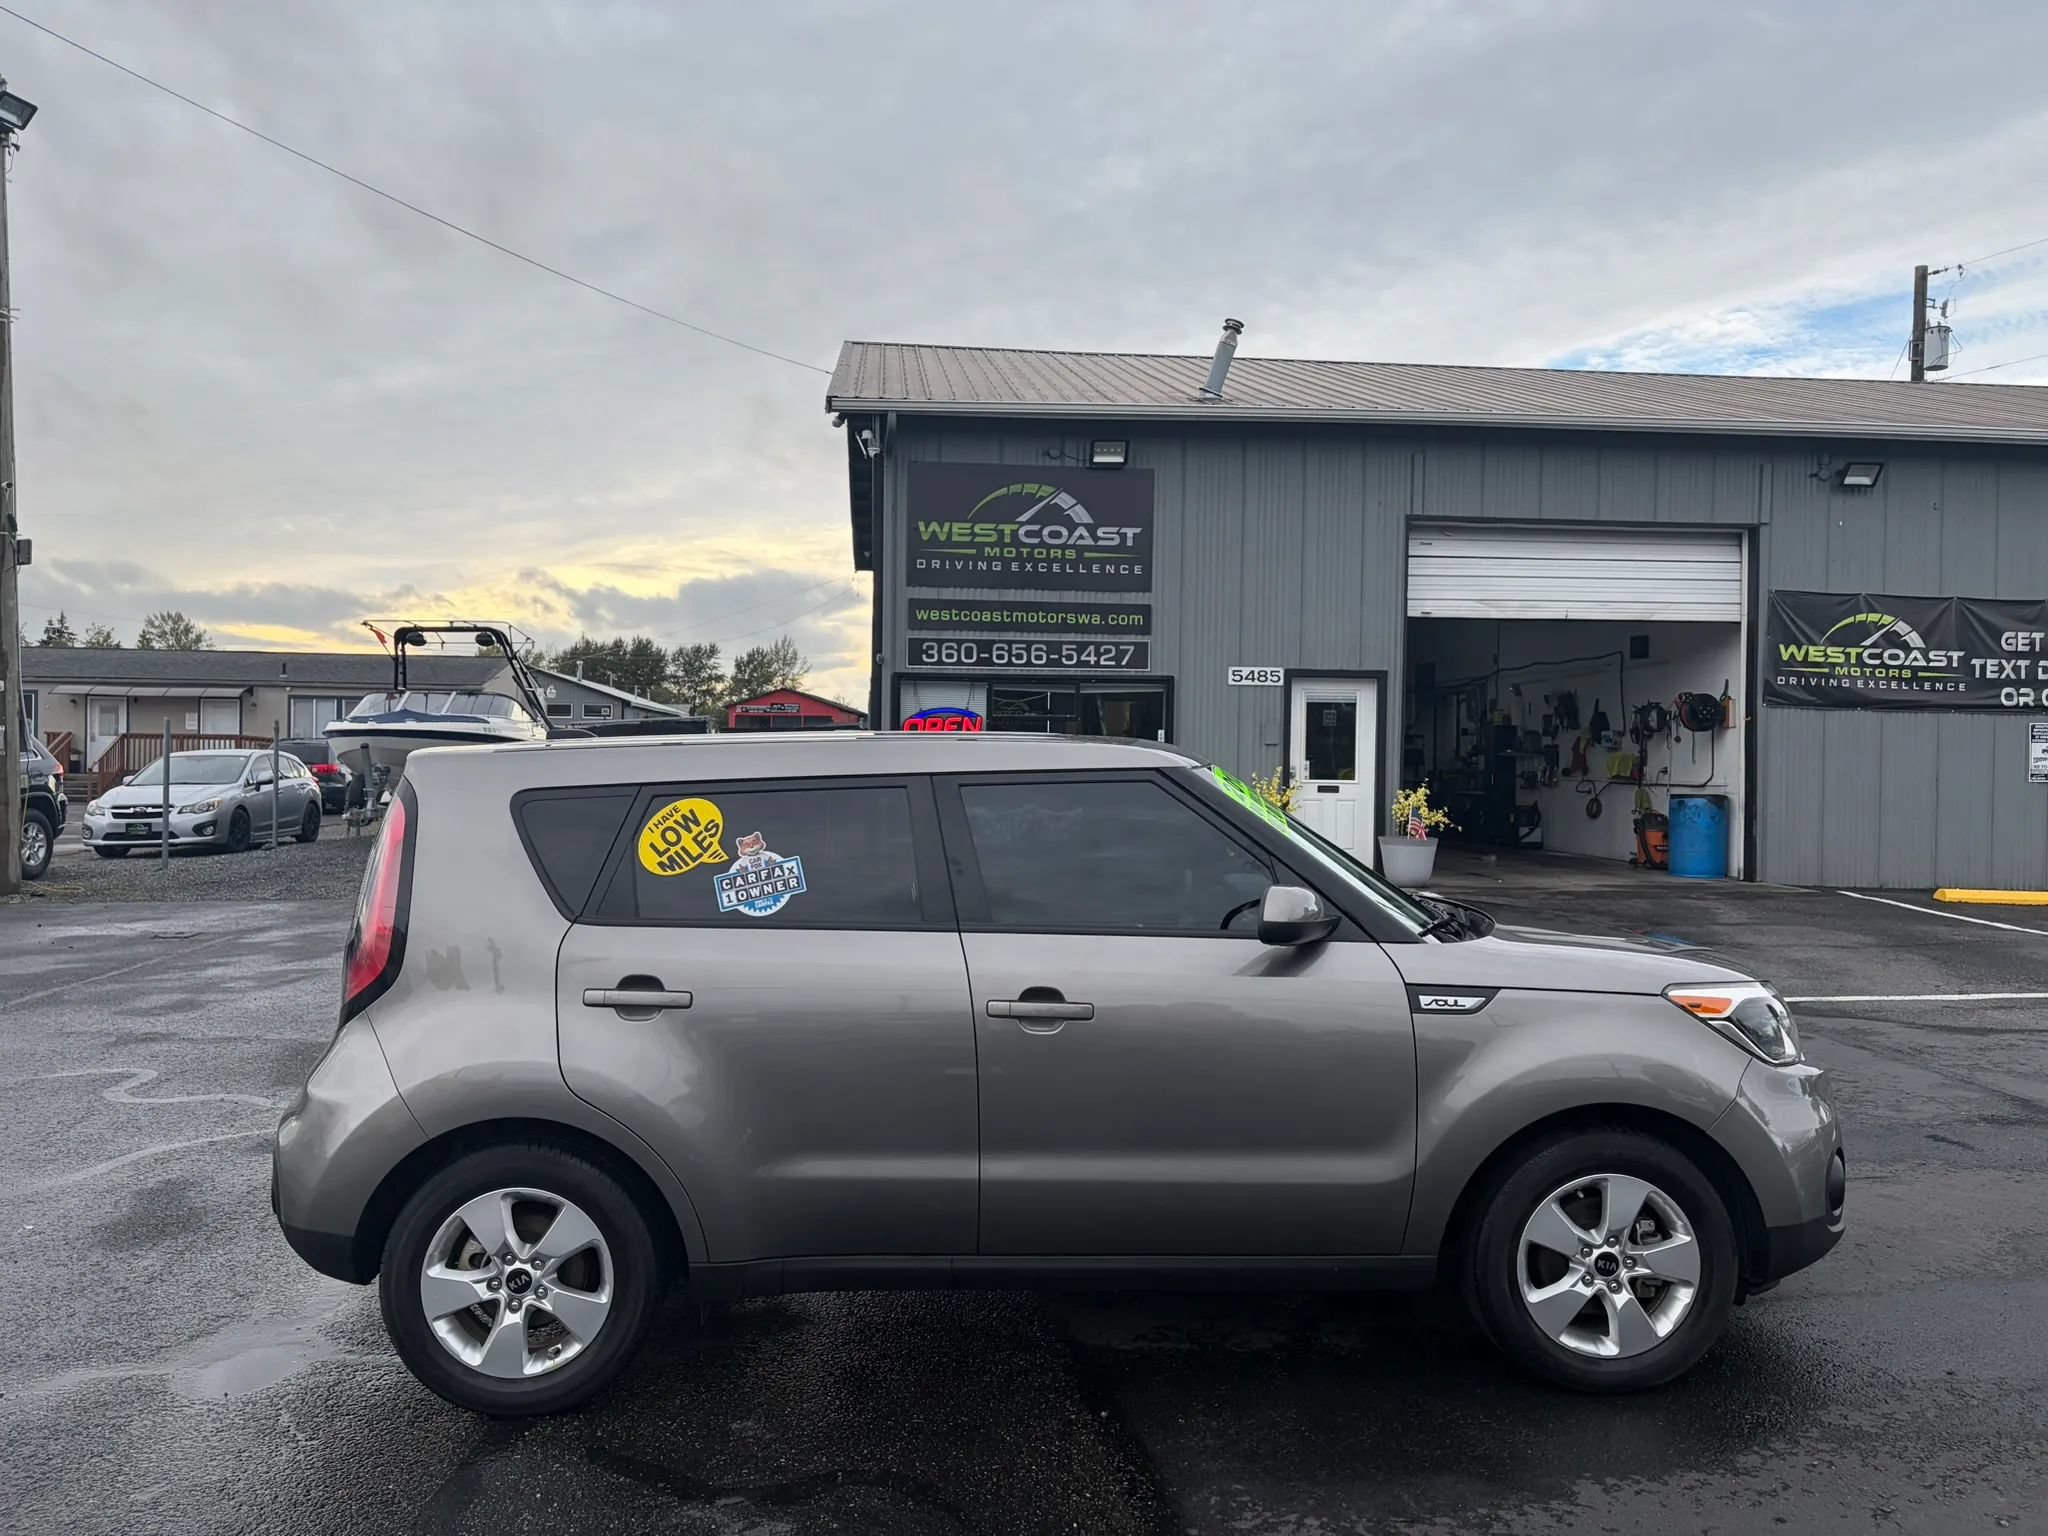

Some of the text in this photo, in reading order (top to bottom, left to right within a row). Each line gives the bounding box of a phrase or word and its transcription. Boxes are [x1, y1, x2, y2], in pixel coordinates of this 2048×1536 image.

[918, 521, 1143, 546] WESTCOAST
[984, 547, 1077, 559] MOTORS
[916, 559, 1143, 574] DRIVING EXCELLENCE
[915, 608, 1144, 625] westcoastmotorswa.com
[2000, 631, 2046, 652] GET
[921, 642, 1136, 666] 360-656-5427
[1779, 644, 1965, 667] WESTCOAST
[1231, 669, 1281, 683] 5485
[1835, 667, 1912, 678] MOTORS
[1970, 658, 2031, 679] TEXT
[1777, 676, 1966, 691] DRIVING EXCELLENCE
[2000, 687, 2035, 707] OR
[654, 805, 681, 830] HAVE
[649, 808, 702, 858] LOW
[656, 818, 720, 873] MILES
[722, 866, 795, 890] CARFAX
[725, 894, 733, 904] 1
[737, 879, 799, 901] OWNER
[1597, 1260, 1617, 1271] KIA
[508, 1274, 530, 1290] KIA
